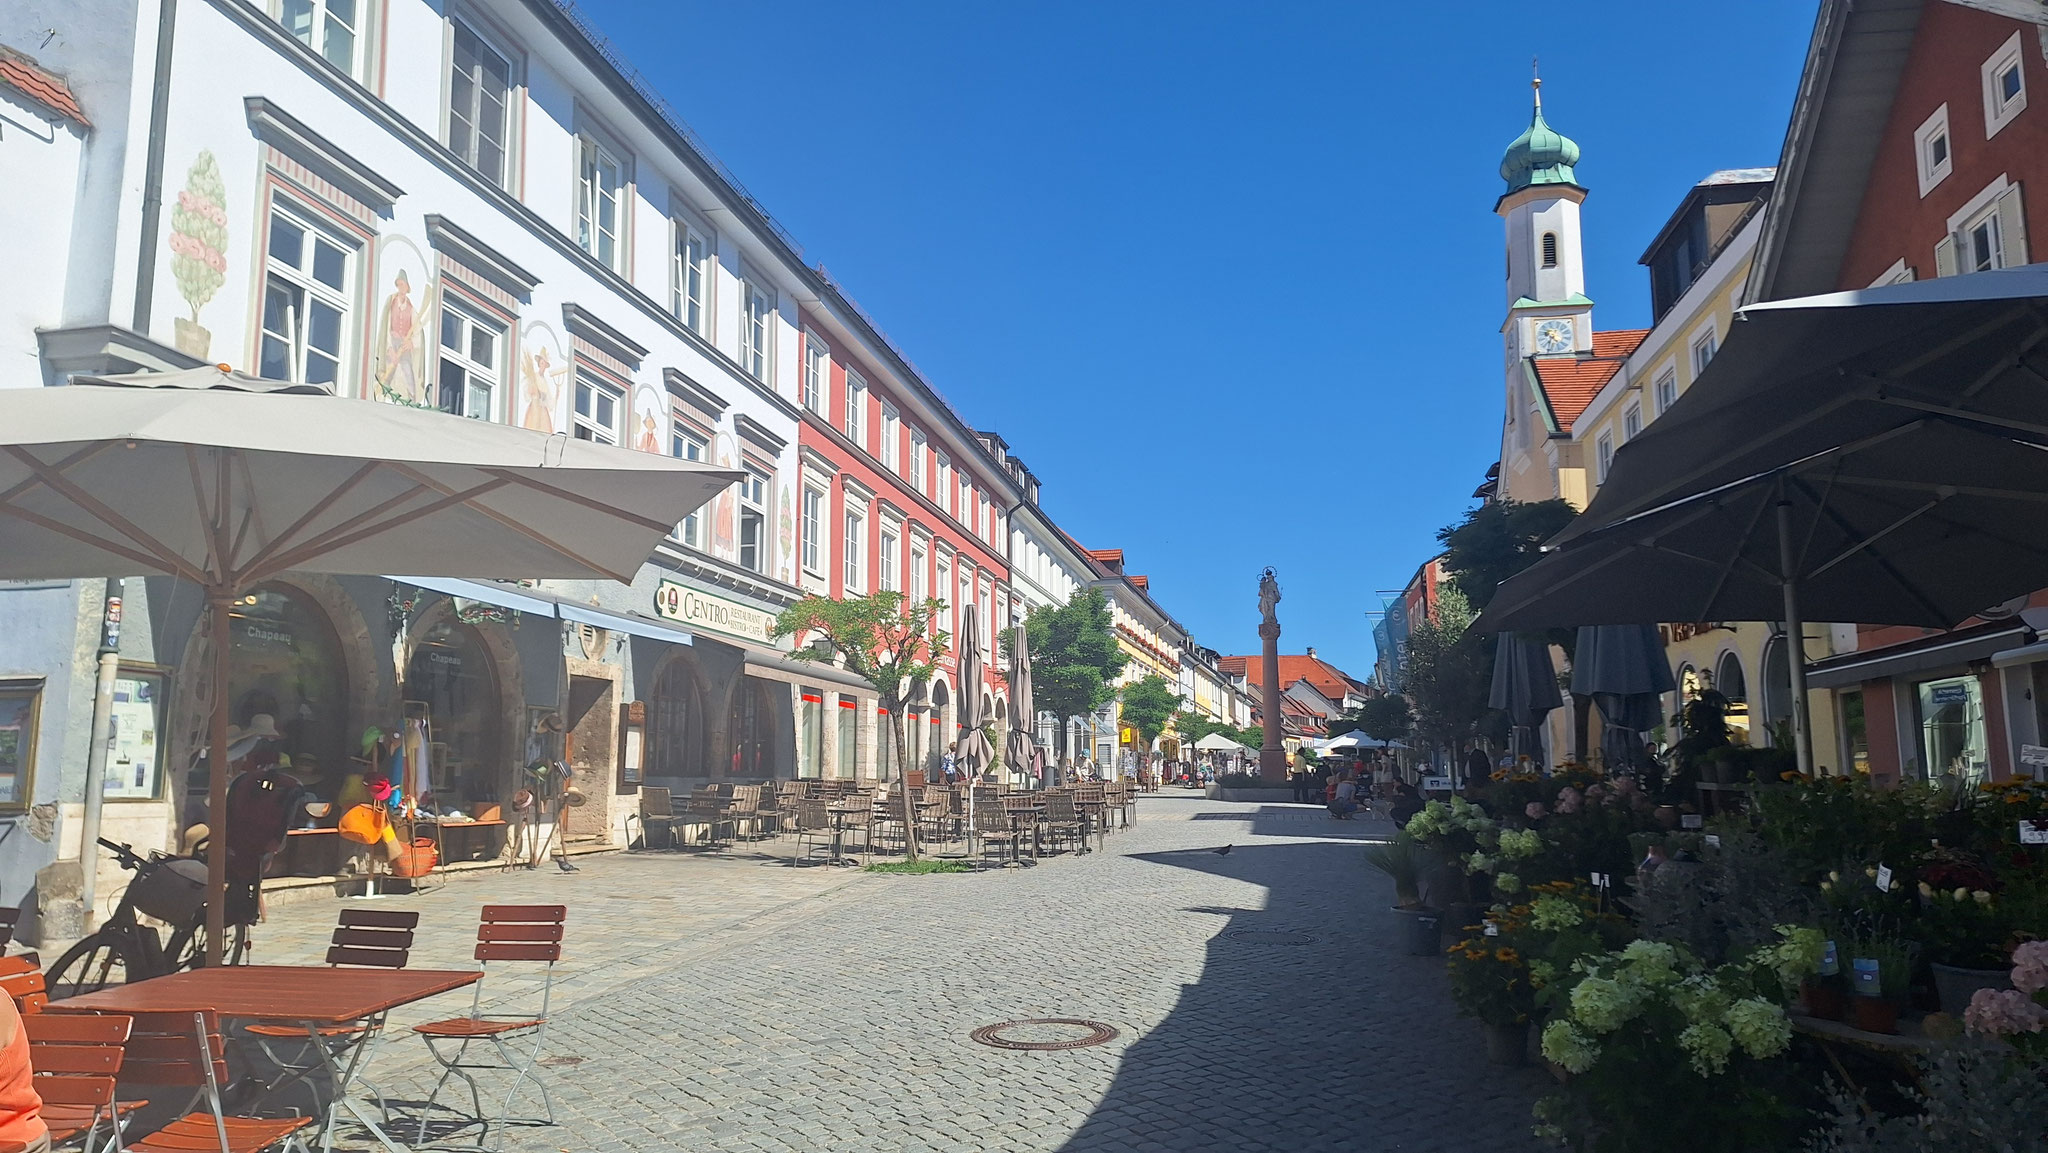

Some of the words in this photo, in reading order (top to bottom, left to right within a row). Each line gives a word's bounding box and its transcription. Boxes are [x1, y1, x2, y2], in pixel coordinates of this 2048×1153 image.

[684, 592, 728, 625] CENTRO
[730, 607, 762, 624] RESTAURANT
[247, 625, 291, 641] Chapeau
[430, 652, 461, 665] Chapeau
